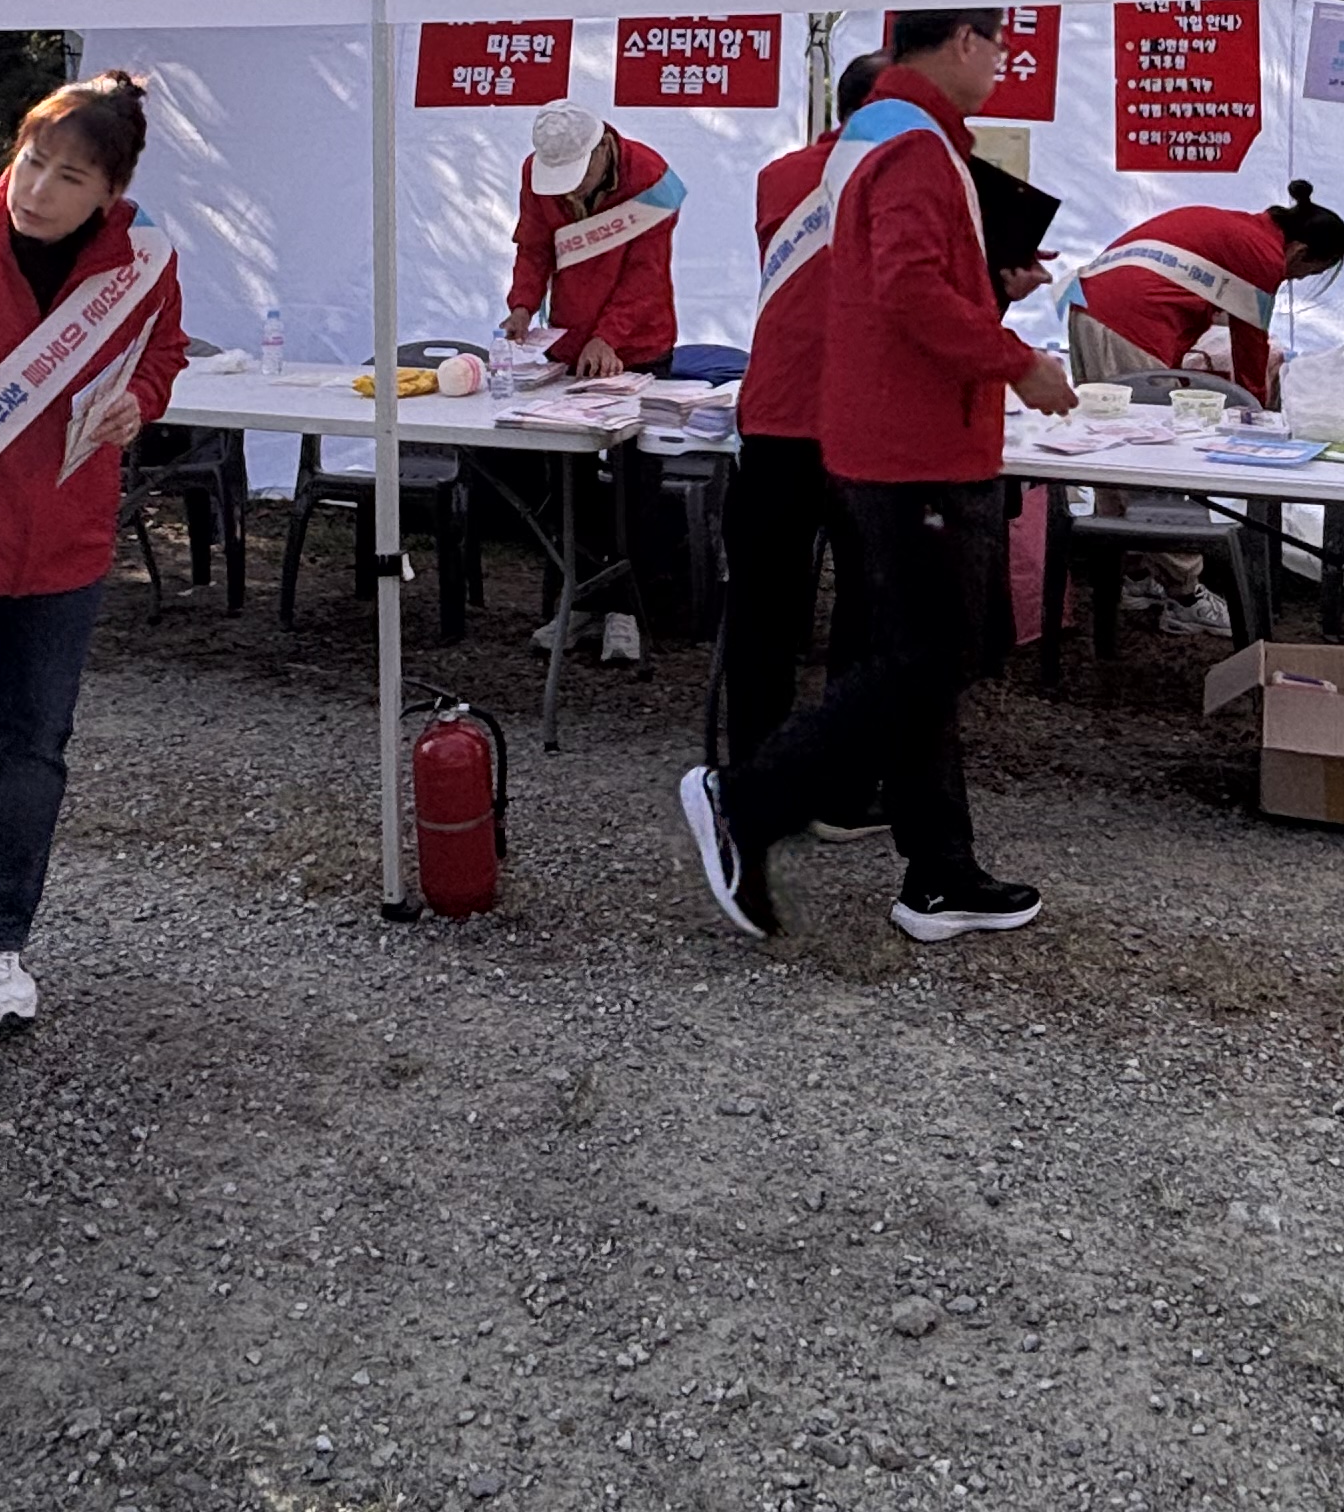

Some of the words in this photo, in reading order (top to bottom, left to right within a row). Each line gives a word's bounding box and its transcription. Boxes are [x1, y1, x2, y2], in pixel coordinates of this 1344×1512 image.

[486, 33, 556, 64] 따뜻한
[451, 65, 516, 96] 희망을
[659, 64, 729, 95] 촘촘히
